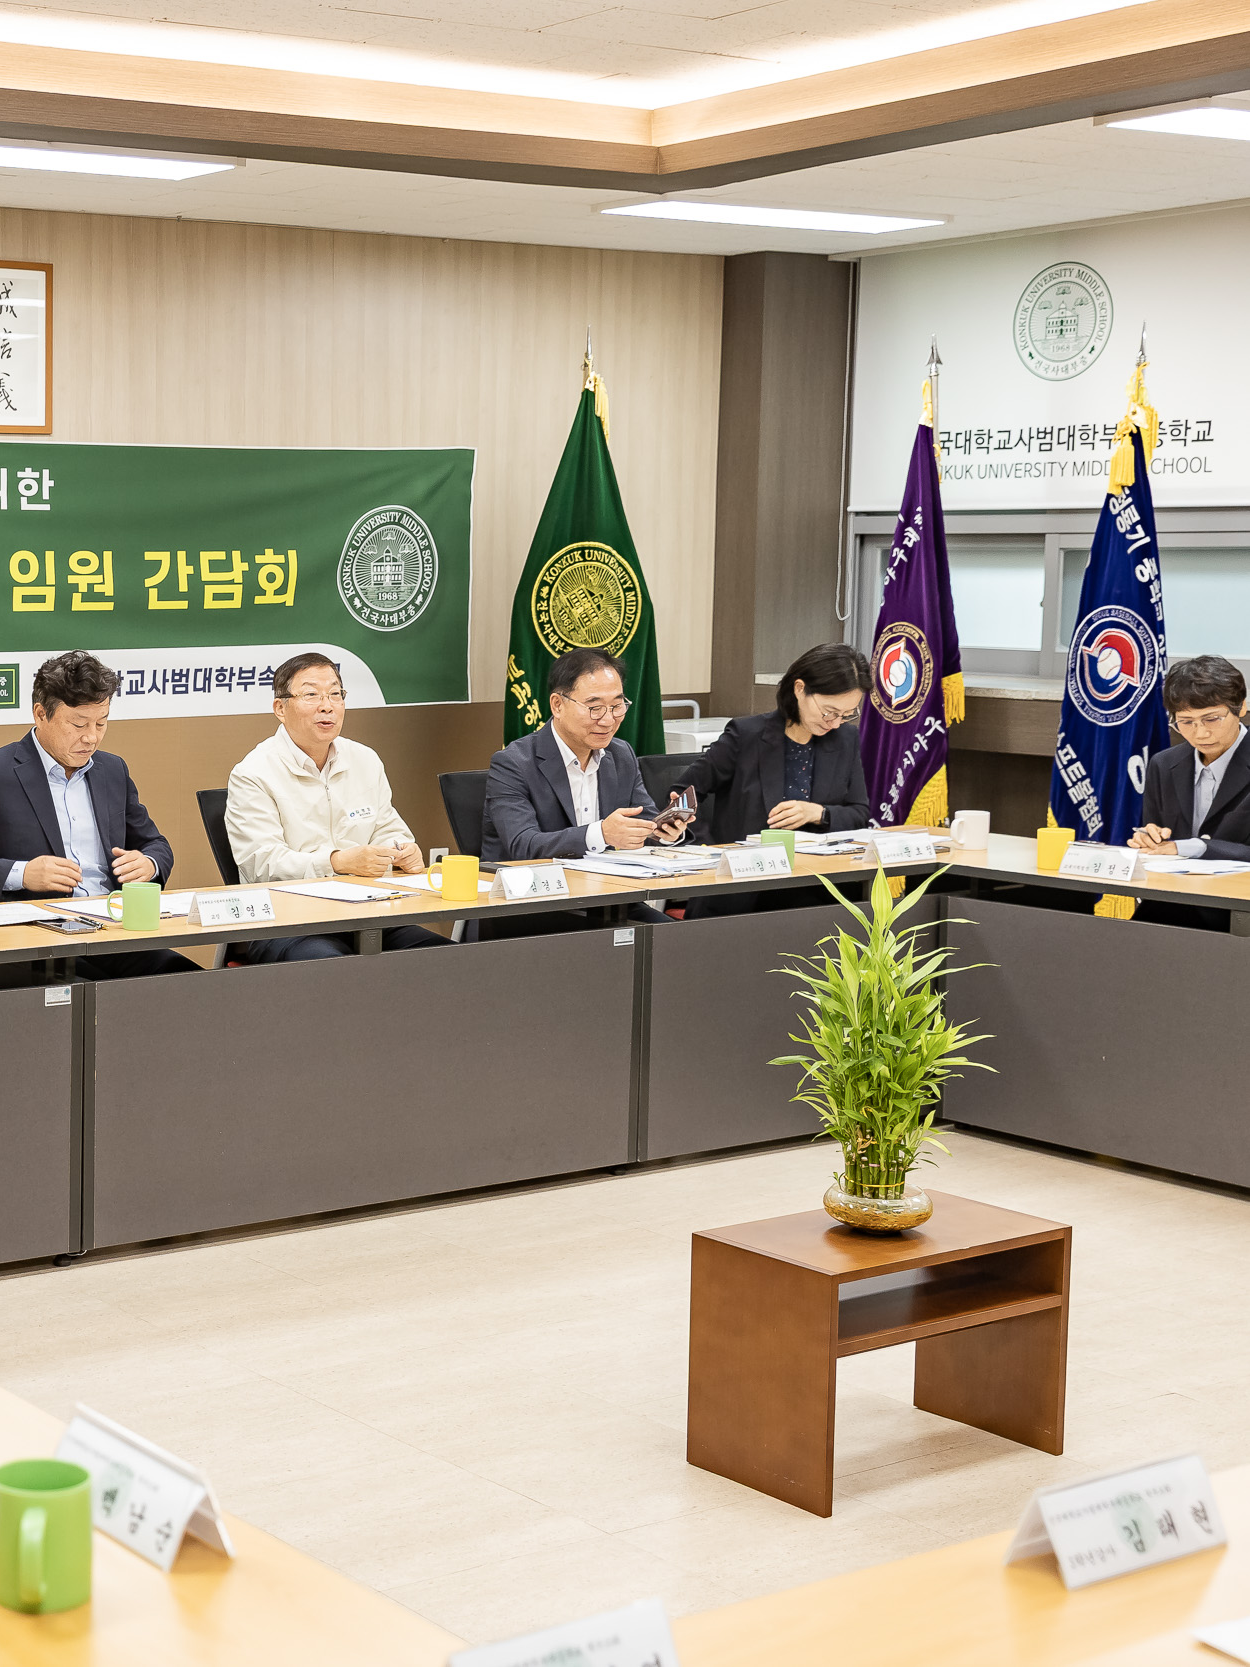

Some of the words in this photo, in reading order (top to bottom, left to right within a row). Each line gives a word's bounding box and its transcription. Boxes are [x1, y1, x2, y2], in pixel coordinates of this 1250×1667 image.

[1018, 306, 1030, 351] KONKUK
[1025, 268, 1075, 304] UNIVERSITY
[1075, 269, 1105, 301] MIDDLE
[1094, 301, 1108, 343] SCHOOL
[940, 464, 974, 481] KUK
[978, 461, 1069, 480] UNIVERSITY
[1072, 459, 1111, 477] MIDD
[1150, 456, 1212, 475] CHOOL
[342, 547, 357, 598] KONKUK
[352, 511, 402, 547] UNIVERSITY
[400, 513, 429, 549] MIDDLE
[420, 549, 433, 592] SCHOOL
[543, 550, 583, 584] KONKUK
[9, 548, 115, 612] 임원
[144, 547, 299, 609] 간담회
[378, 592, 398, 601] 1968
[360, 604, 416, 627] 건국사대부중
